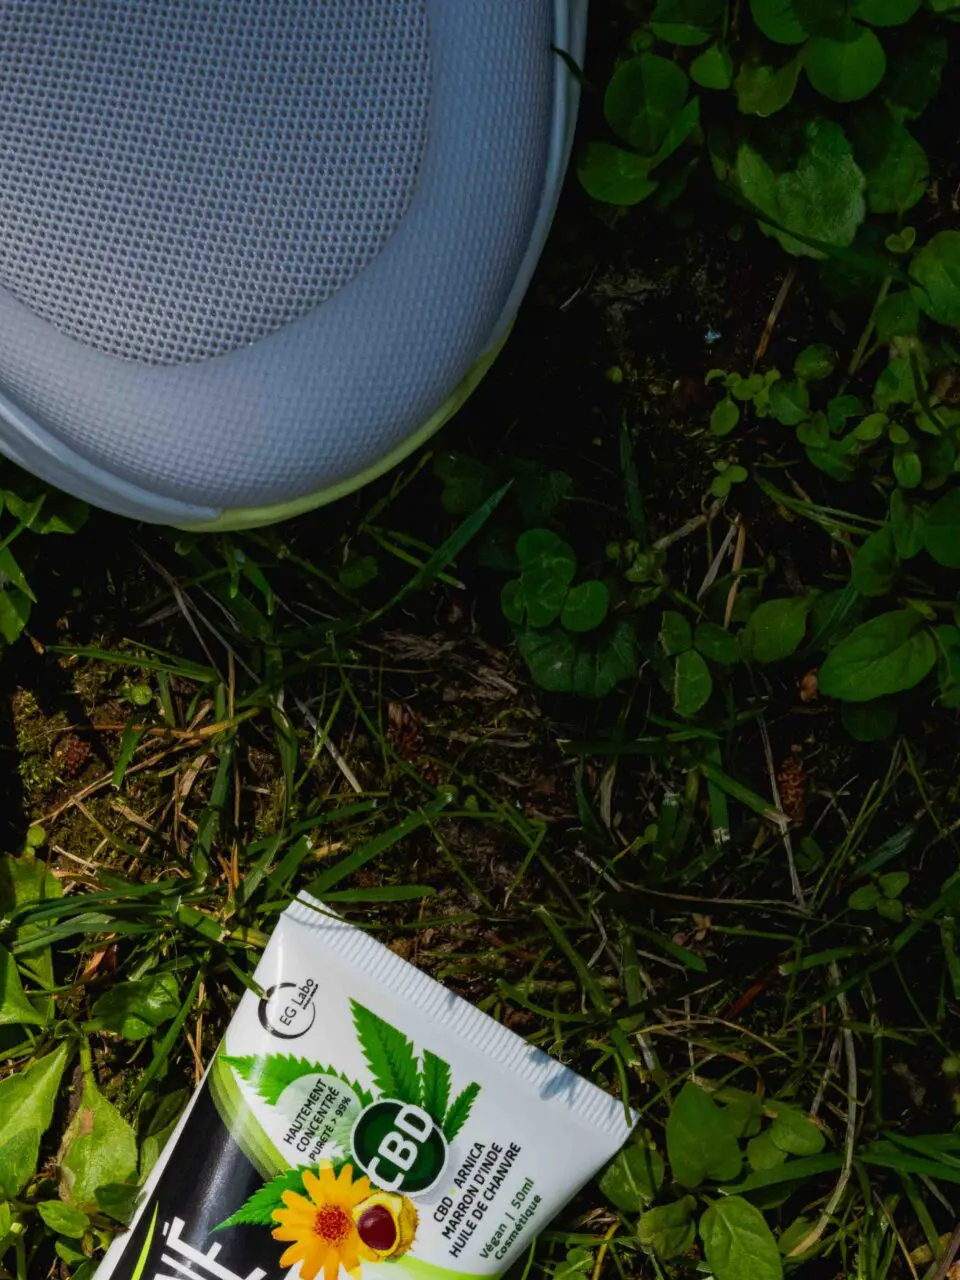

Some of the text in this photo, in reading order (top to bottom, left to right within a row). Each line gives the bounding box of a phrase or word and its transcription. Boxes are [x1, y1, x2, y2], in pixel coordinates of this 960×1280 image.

[279, 1006, 297, 1026] EG
[291, 978, 315, 1006] Labo
[283, 1078, 327, 1145] HAUTEMENT
[296, 1086, 340, 1153] CONCENTRÉ
[308, 1126, 334, 1161] PURETÉ
[336, 1096, 352, 1118] 99%
[366, 1104, 434, 1193] CBD
[433, 1141, 486, 1223] CBD ARNICA
[441, 1142, 503, 1240] MARRON D'INDE
[448, 1141, 521, 1258] HUILE DE CHANVRE
[479, 1177, 535, 1260] Végan 50ml
[494, 1194, 542, 1261] Cosmétique
